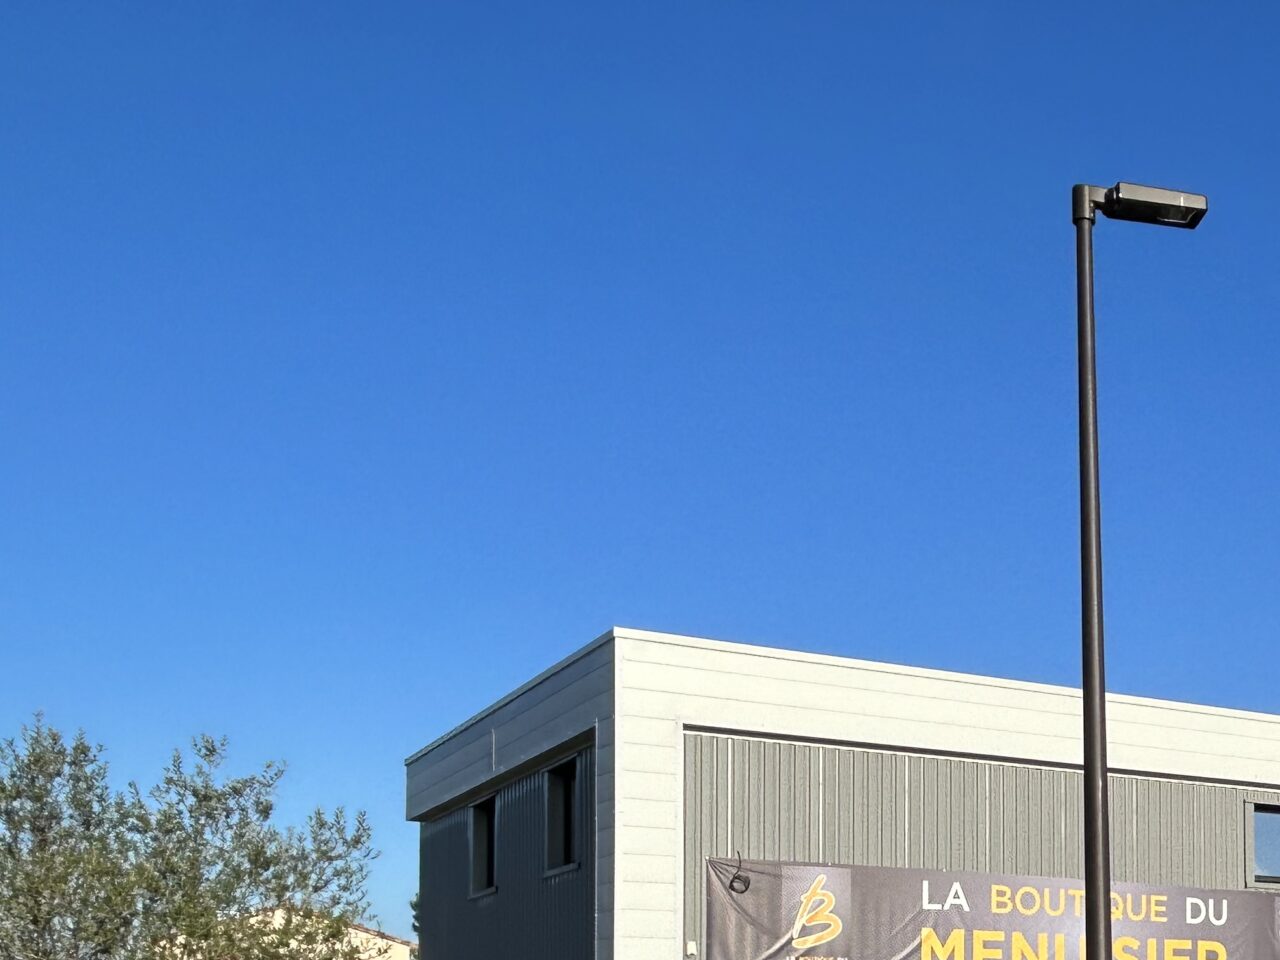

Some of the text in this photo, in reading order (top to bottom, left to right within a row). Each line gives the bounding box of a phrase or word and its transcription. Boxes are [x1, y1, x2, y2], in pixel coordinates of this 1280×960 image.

[922, 879, 1228, 926] LA BOUTQUE DU
